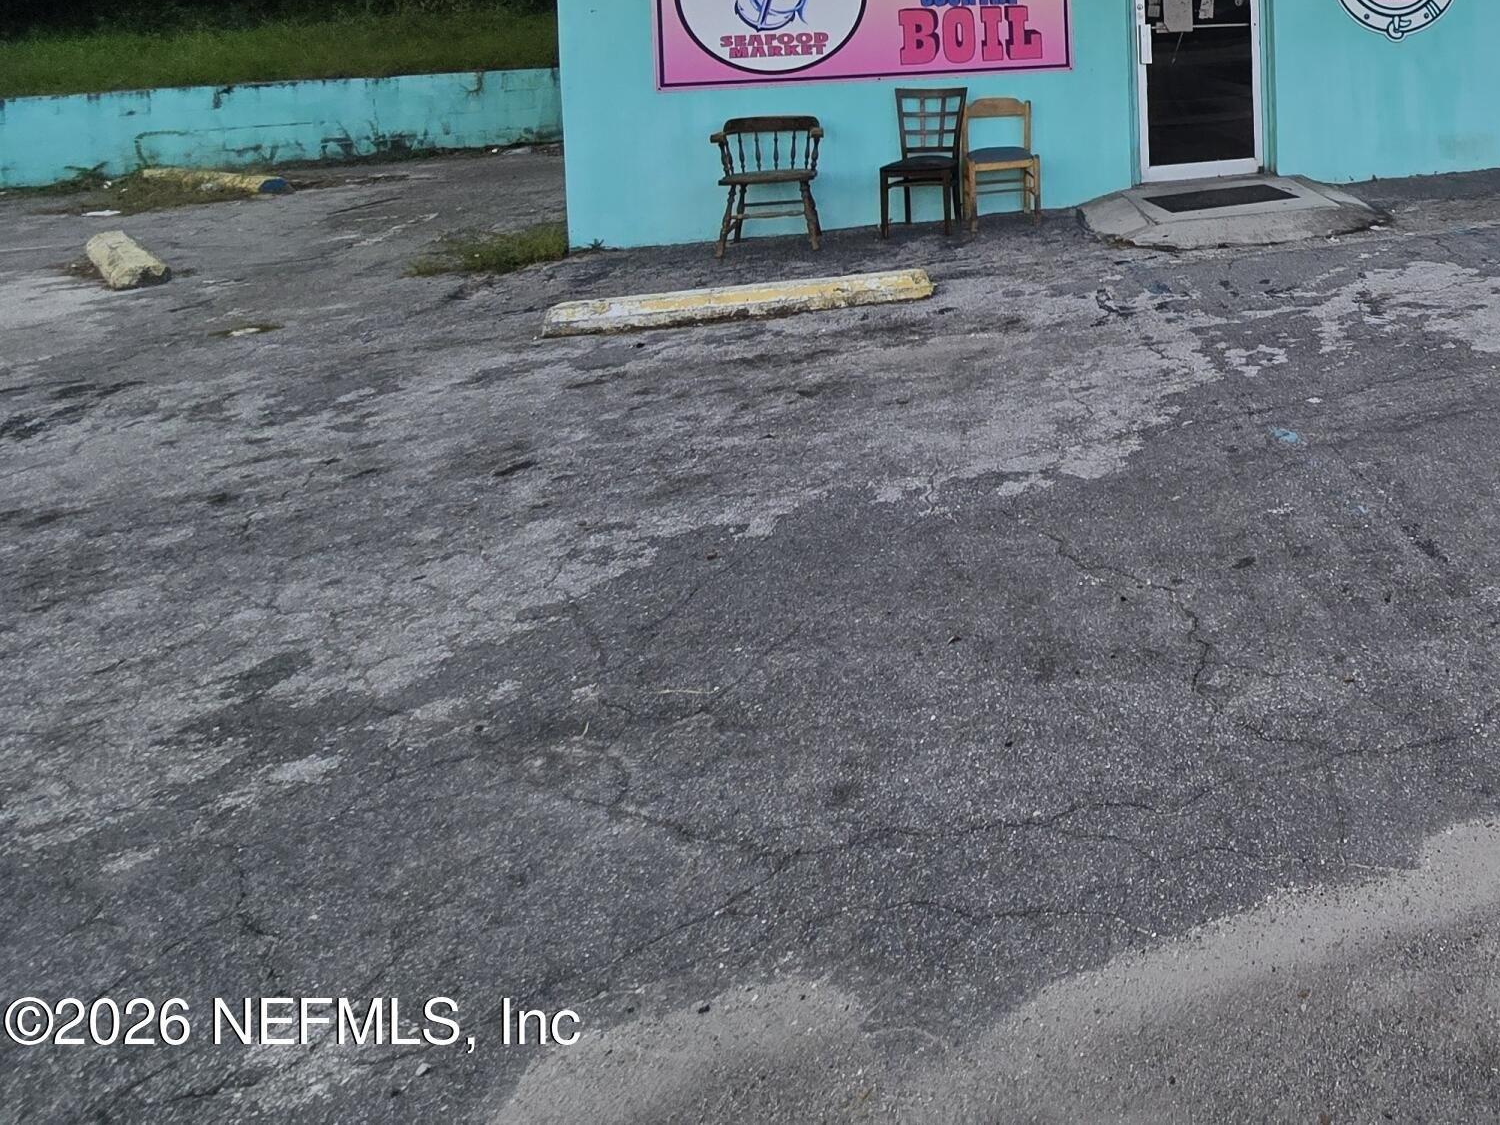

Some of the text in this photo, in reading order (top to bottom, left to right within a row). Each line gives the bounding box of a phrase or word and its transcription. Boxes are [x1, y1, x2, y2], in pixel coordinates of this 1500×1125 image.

[720, 31, 829, 47] SEAFOOD
[898, 5, 1043, 65] BOIL
[729, 43, 826, 59] MARKET
